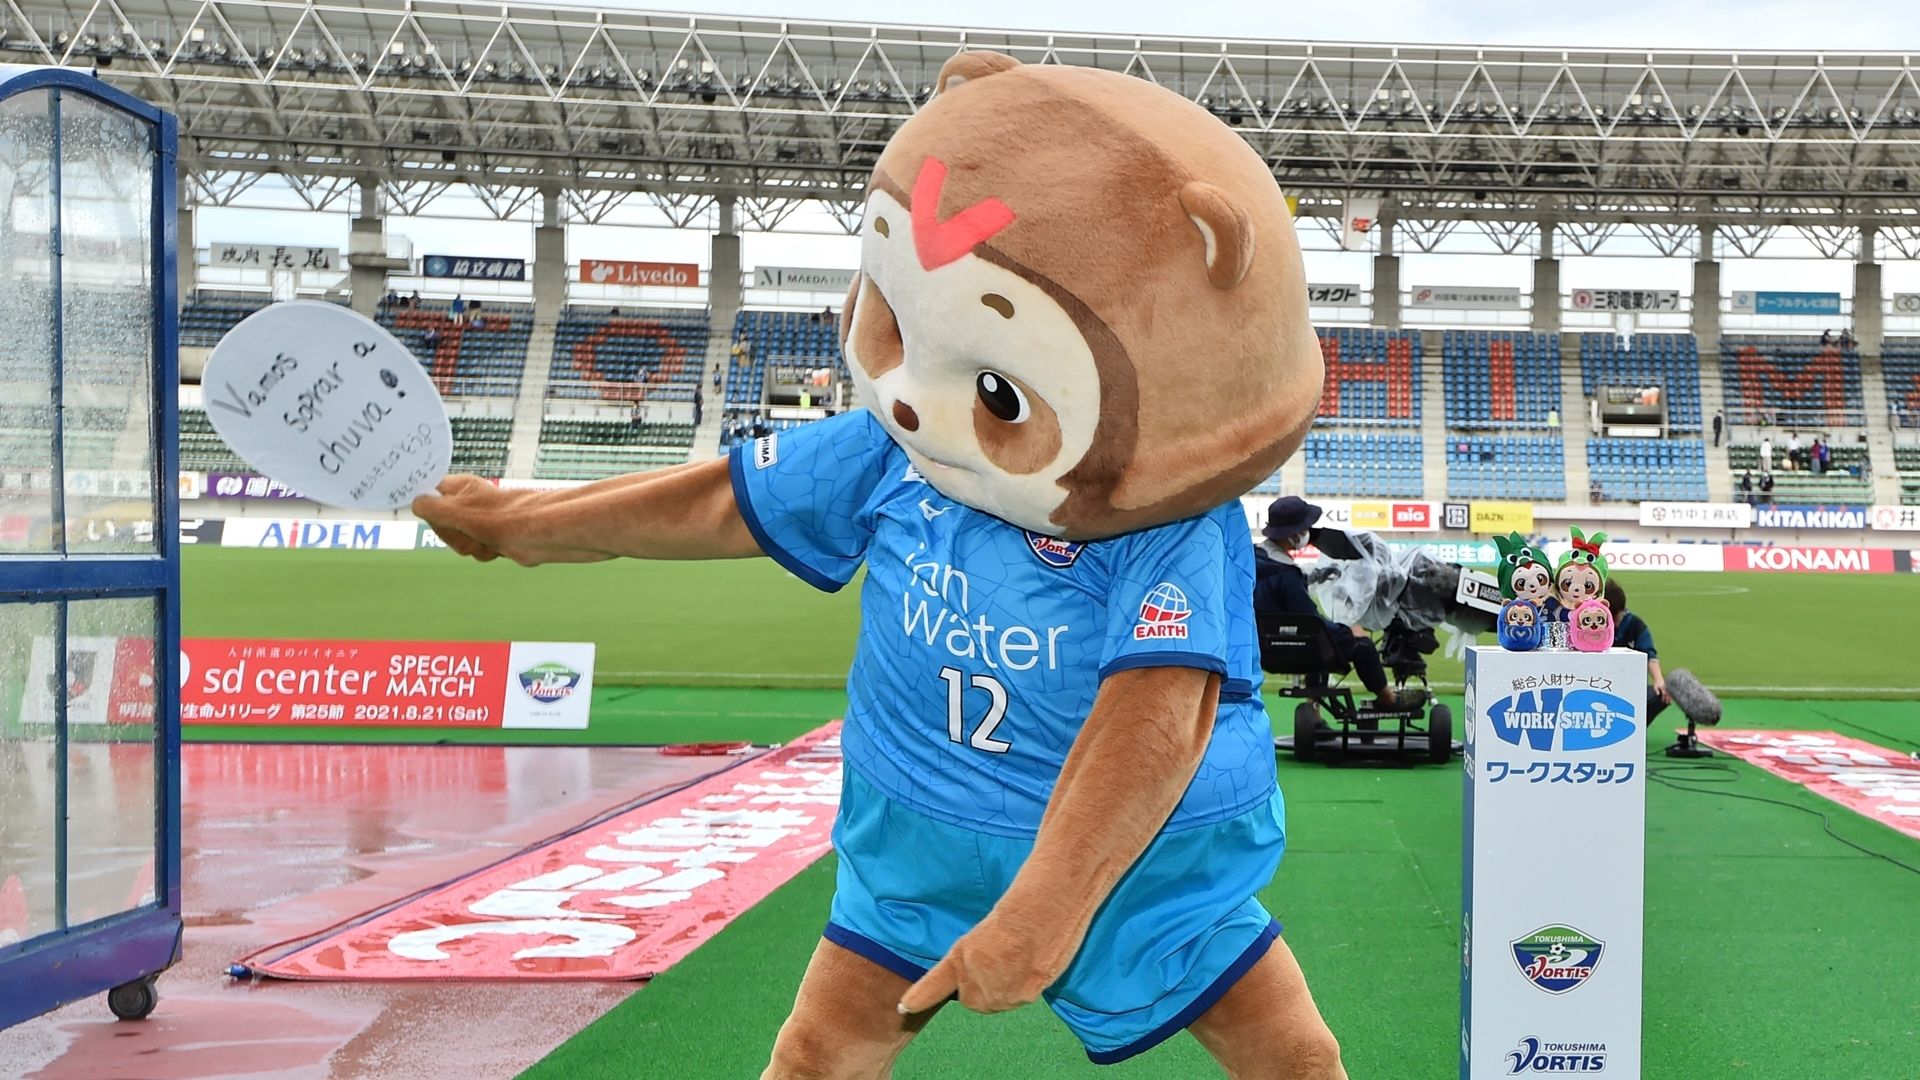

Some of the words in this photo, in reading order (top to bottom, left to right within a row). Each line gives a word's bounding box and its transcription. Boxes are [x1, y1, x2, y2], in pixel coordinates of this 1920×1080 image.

[617, 268, 688, 285] Livedo
[787, 274, 828, 285] MAEDA
[1594, 291, 1679, 310] 三和電業グループ
[353, 341, 377, 358] a
[211, 351, 298, 418] Vamos
[1605, 553, 1686, 567] ocomo
[1747, 548, 1870, 571] KONAMI
[1135, 624, 1186, 639] EARTH
[387, 655, 484, 677] SPECIAL
[202, 659, 246, 695] sd
[255, 663, 378, 696] center
[385, 676, 476, 698] MATCH
[1512, 673, 1614, 692] 総合人財サービス
[938, 665, 1013, 754] 12
[1503, 711, 1556, 730] WORK
[1560, 711, 1616, 730] STAFF
[1486, 761, 1635, 784] ワークスタッフ
[1534, 935, 1584, 944] TOKUSHIMA
[1544, 1043, 1606, 1052] TOKUSHIMA
